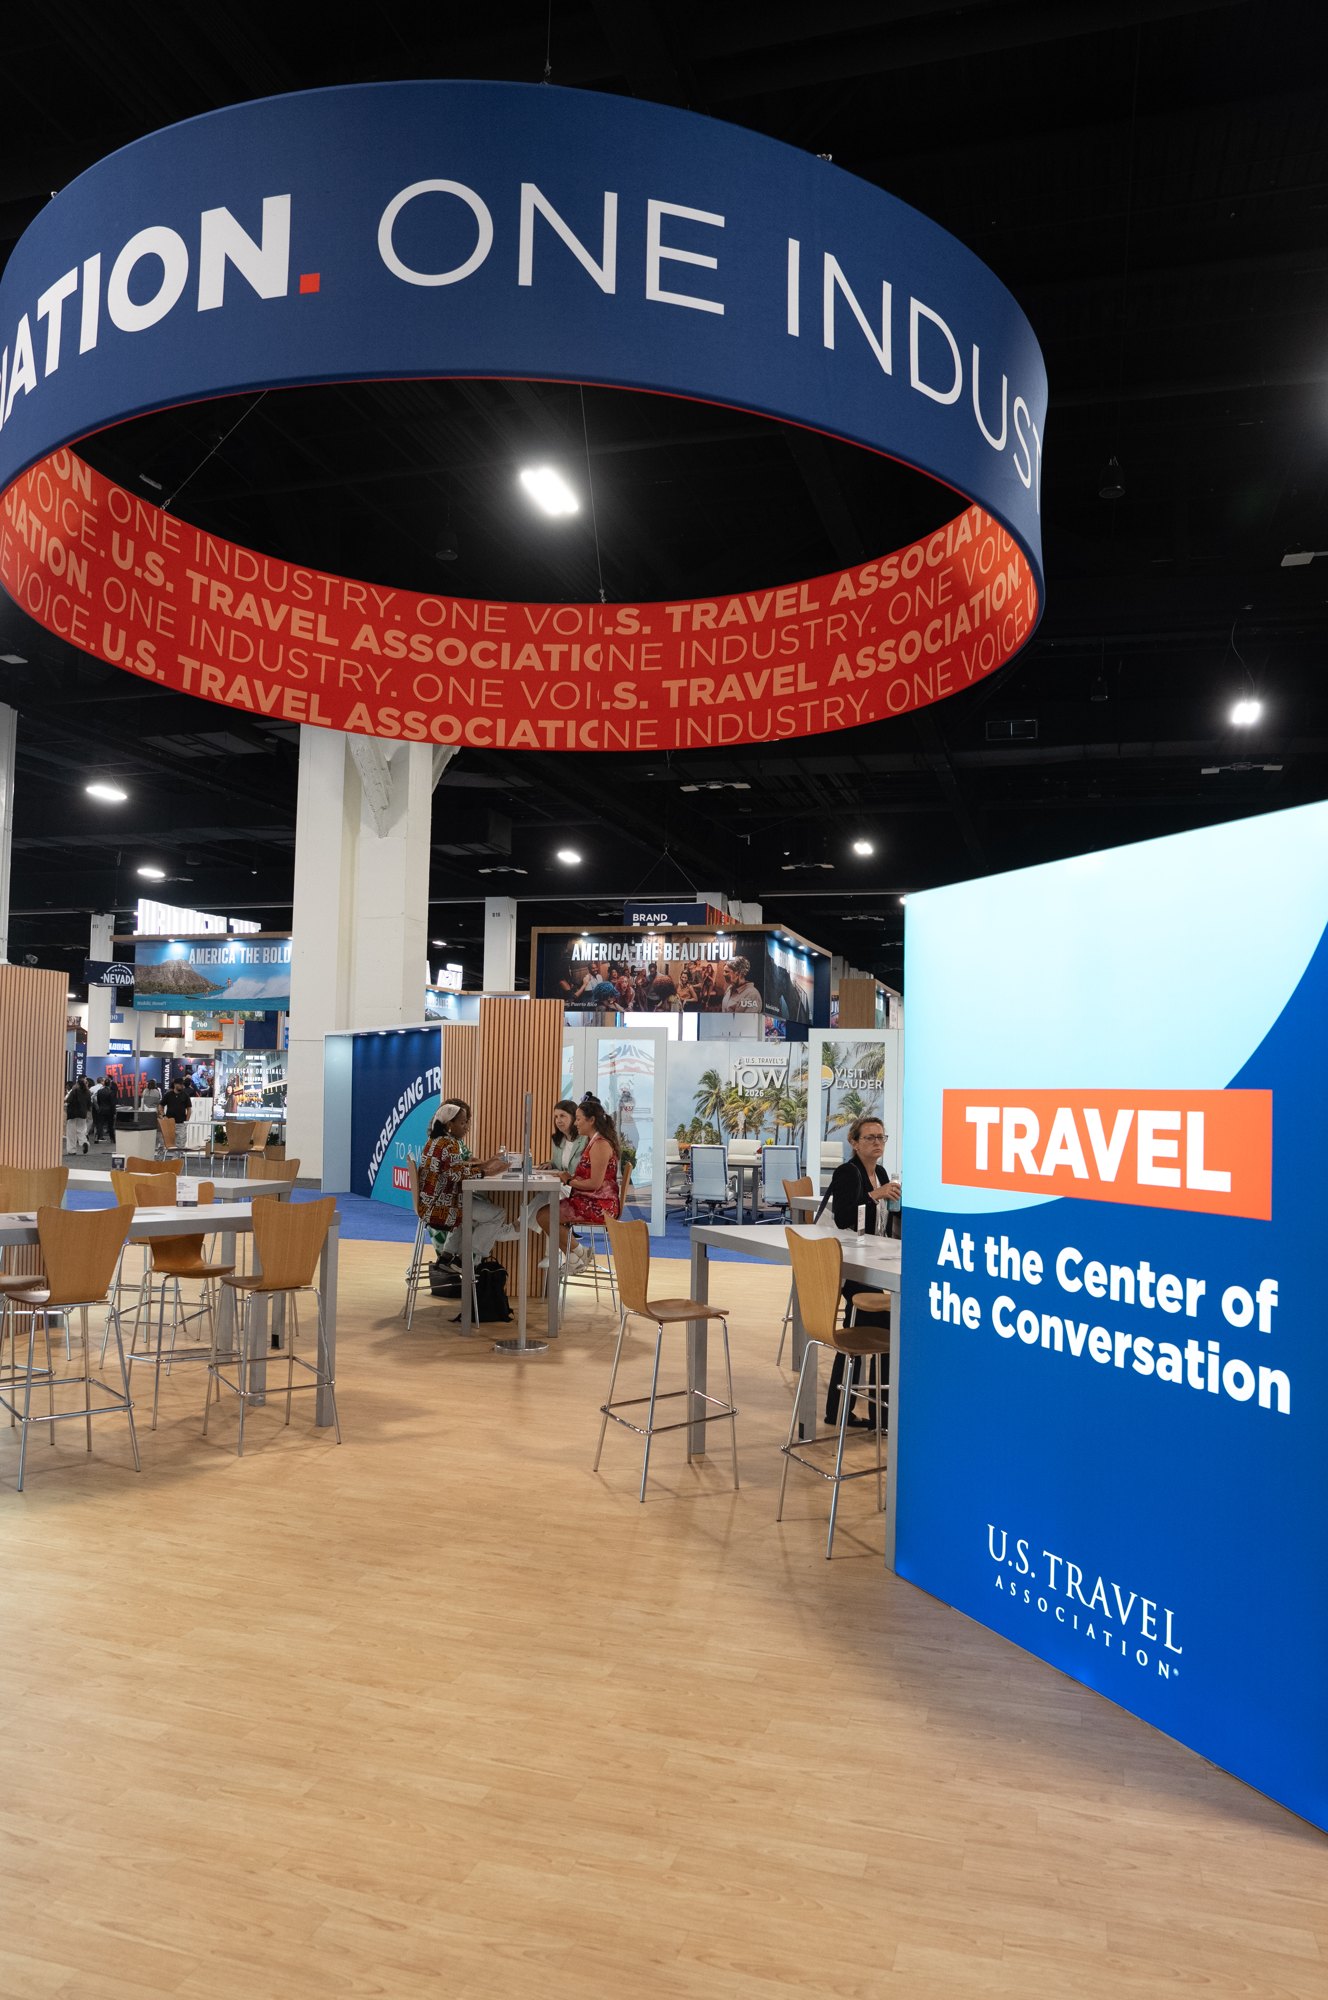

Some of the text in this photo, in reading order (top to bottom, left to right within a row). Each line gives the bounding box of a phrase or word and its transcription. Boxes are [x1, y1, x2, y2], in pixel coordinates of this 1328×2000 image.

[0, 193, 320, 433] IATION.
[377, 178, 725, 316] ONE
[107, 486, 182, 553] ONE
[195, 531, 401, 621] INDUSTRY.
[416, 598, 508, 633] ONE
[523, 606, 603, 636] VOI
[111, 530, 175, 593] U.S.
[185, 568, 340, 647] TRAVEL
[665, 584, 820, 633] TRAVEL
[17, 551, 96, 651] VOICE.
[102, 621, 165, 681] U.S.
[177, 654, 333, 726] TRAVEL
[103, 576, 177, 639] ONE
[190, 615, 398, 698] INDUSTRY.
[412, 673, 505, 709] ONE
[520, 680, 600, 711] VOI
[661, 662, 818, 709] TRAVEL
[828, 552, 1022, 687] ASSOCIATION.
[679, 605, 877, 670] INDUSTRY.
[887, 566, 954, 626] ONE
[675, 690, 876, 747] INDUSTRY.
[886, 658, 954, 713] ONE
[960, 598, 1028, 682] VOICE.
[188, 946, 291, 965] AMERICA THE BOLD
[571, 942, 736, 961] AMERICA THE BEAUTIFUL
[632, 913, 668, 922] BRAND
[103, 973, 135, 985] NEVADA
[740, 999, 759, 1008] USA
[744, 1089, 765, 1097] 2026
[745, 1057, 757, 1065] U.S.
[835, 1068, 865, 1079] VISIT
[367, 1076, 424, 1187] INCREASING
[395, 1141, 406, 1160] TO
[965, 1105, 1232, 1193] TRAVEL
[937, 1228, 1280, 1334] At the Center of
[928, 1281, 1291, 1416] the Conversation
[987, 1523, 1183, 1655] U.S. TRAVEL
